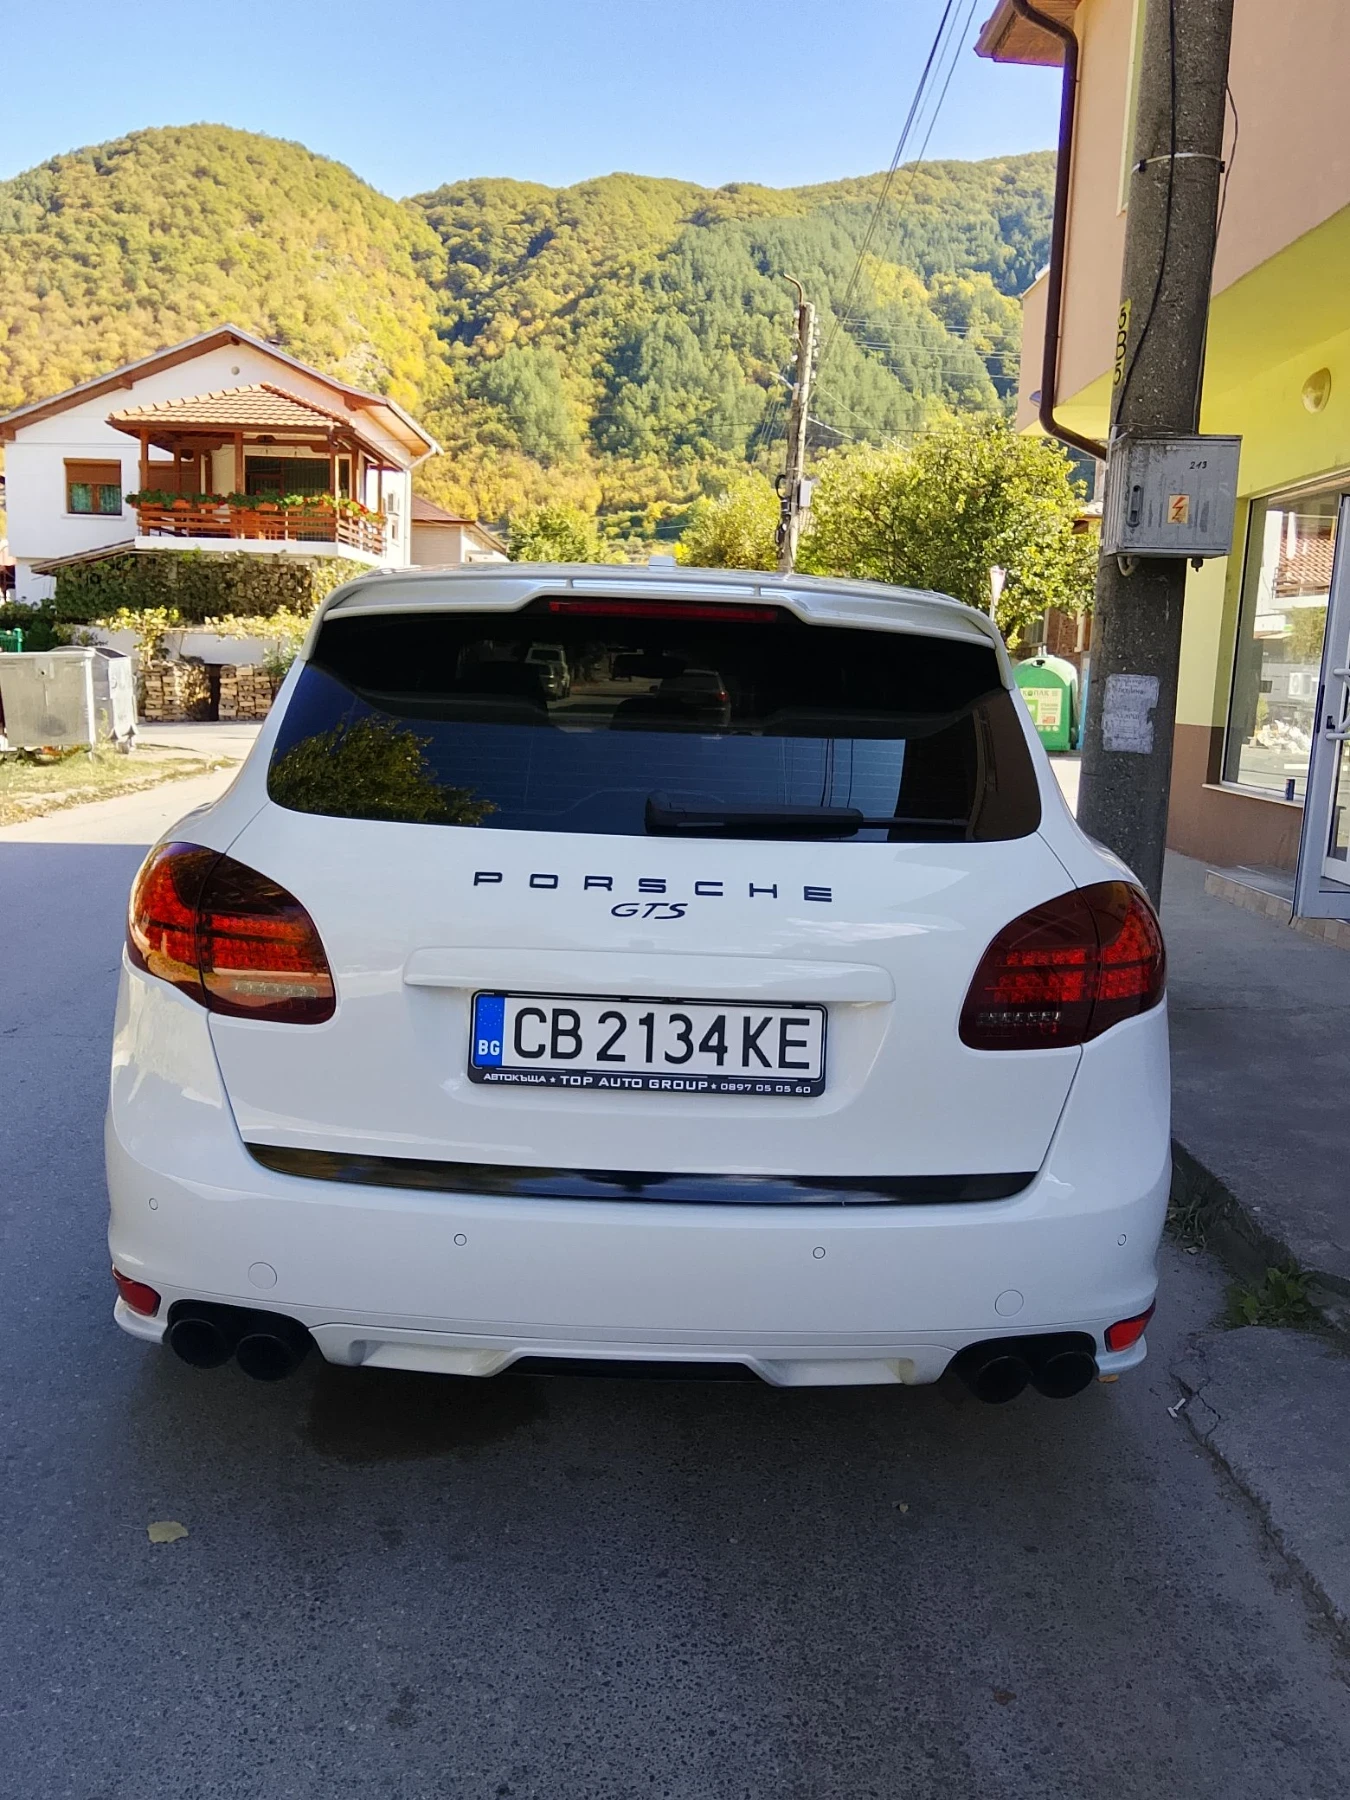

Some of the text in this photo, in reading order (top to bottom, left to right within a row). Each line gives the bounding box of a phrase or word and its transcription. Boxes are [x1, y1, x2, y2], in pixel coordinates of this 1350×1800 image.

[1189, 461, 1208, 470] 213
[473, 871, 832, 903] PORSCHE
[611, 902, 688, 919] GTS
[478, 1039, 500, 1056] BG
[596, 1010, 728, 1067] 2134
[483, 1073, 547, 1083] АВТОКЪЩА
[560, 1075, 593, 1086] TOP
[598, 1077, 643, 1088] AUTO
[648, 1079, 708, 1090] GROUP
[720, 1083, 752, 1091] 0897
[756, 1084, 771, 1092] 05
[795, 1086, 811, 1094] 60
